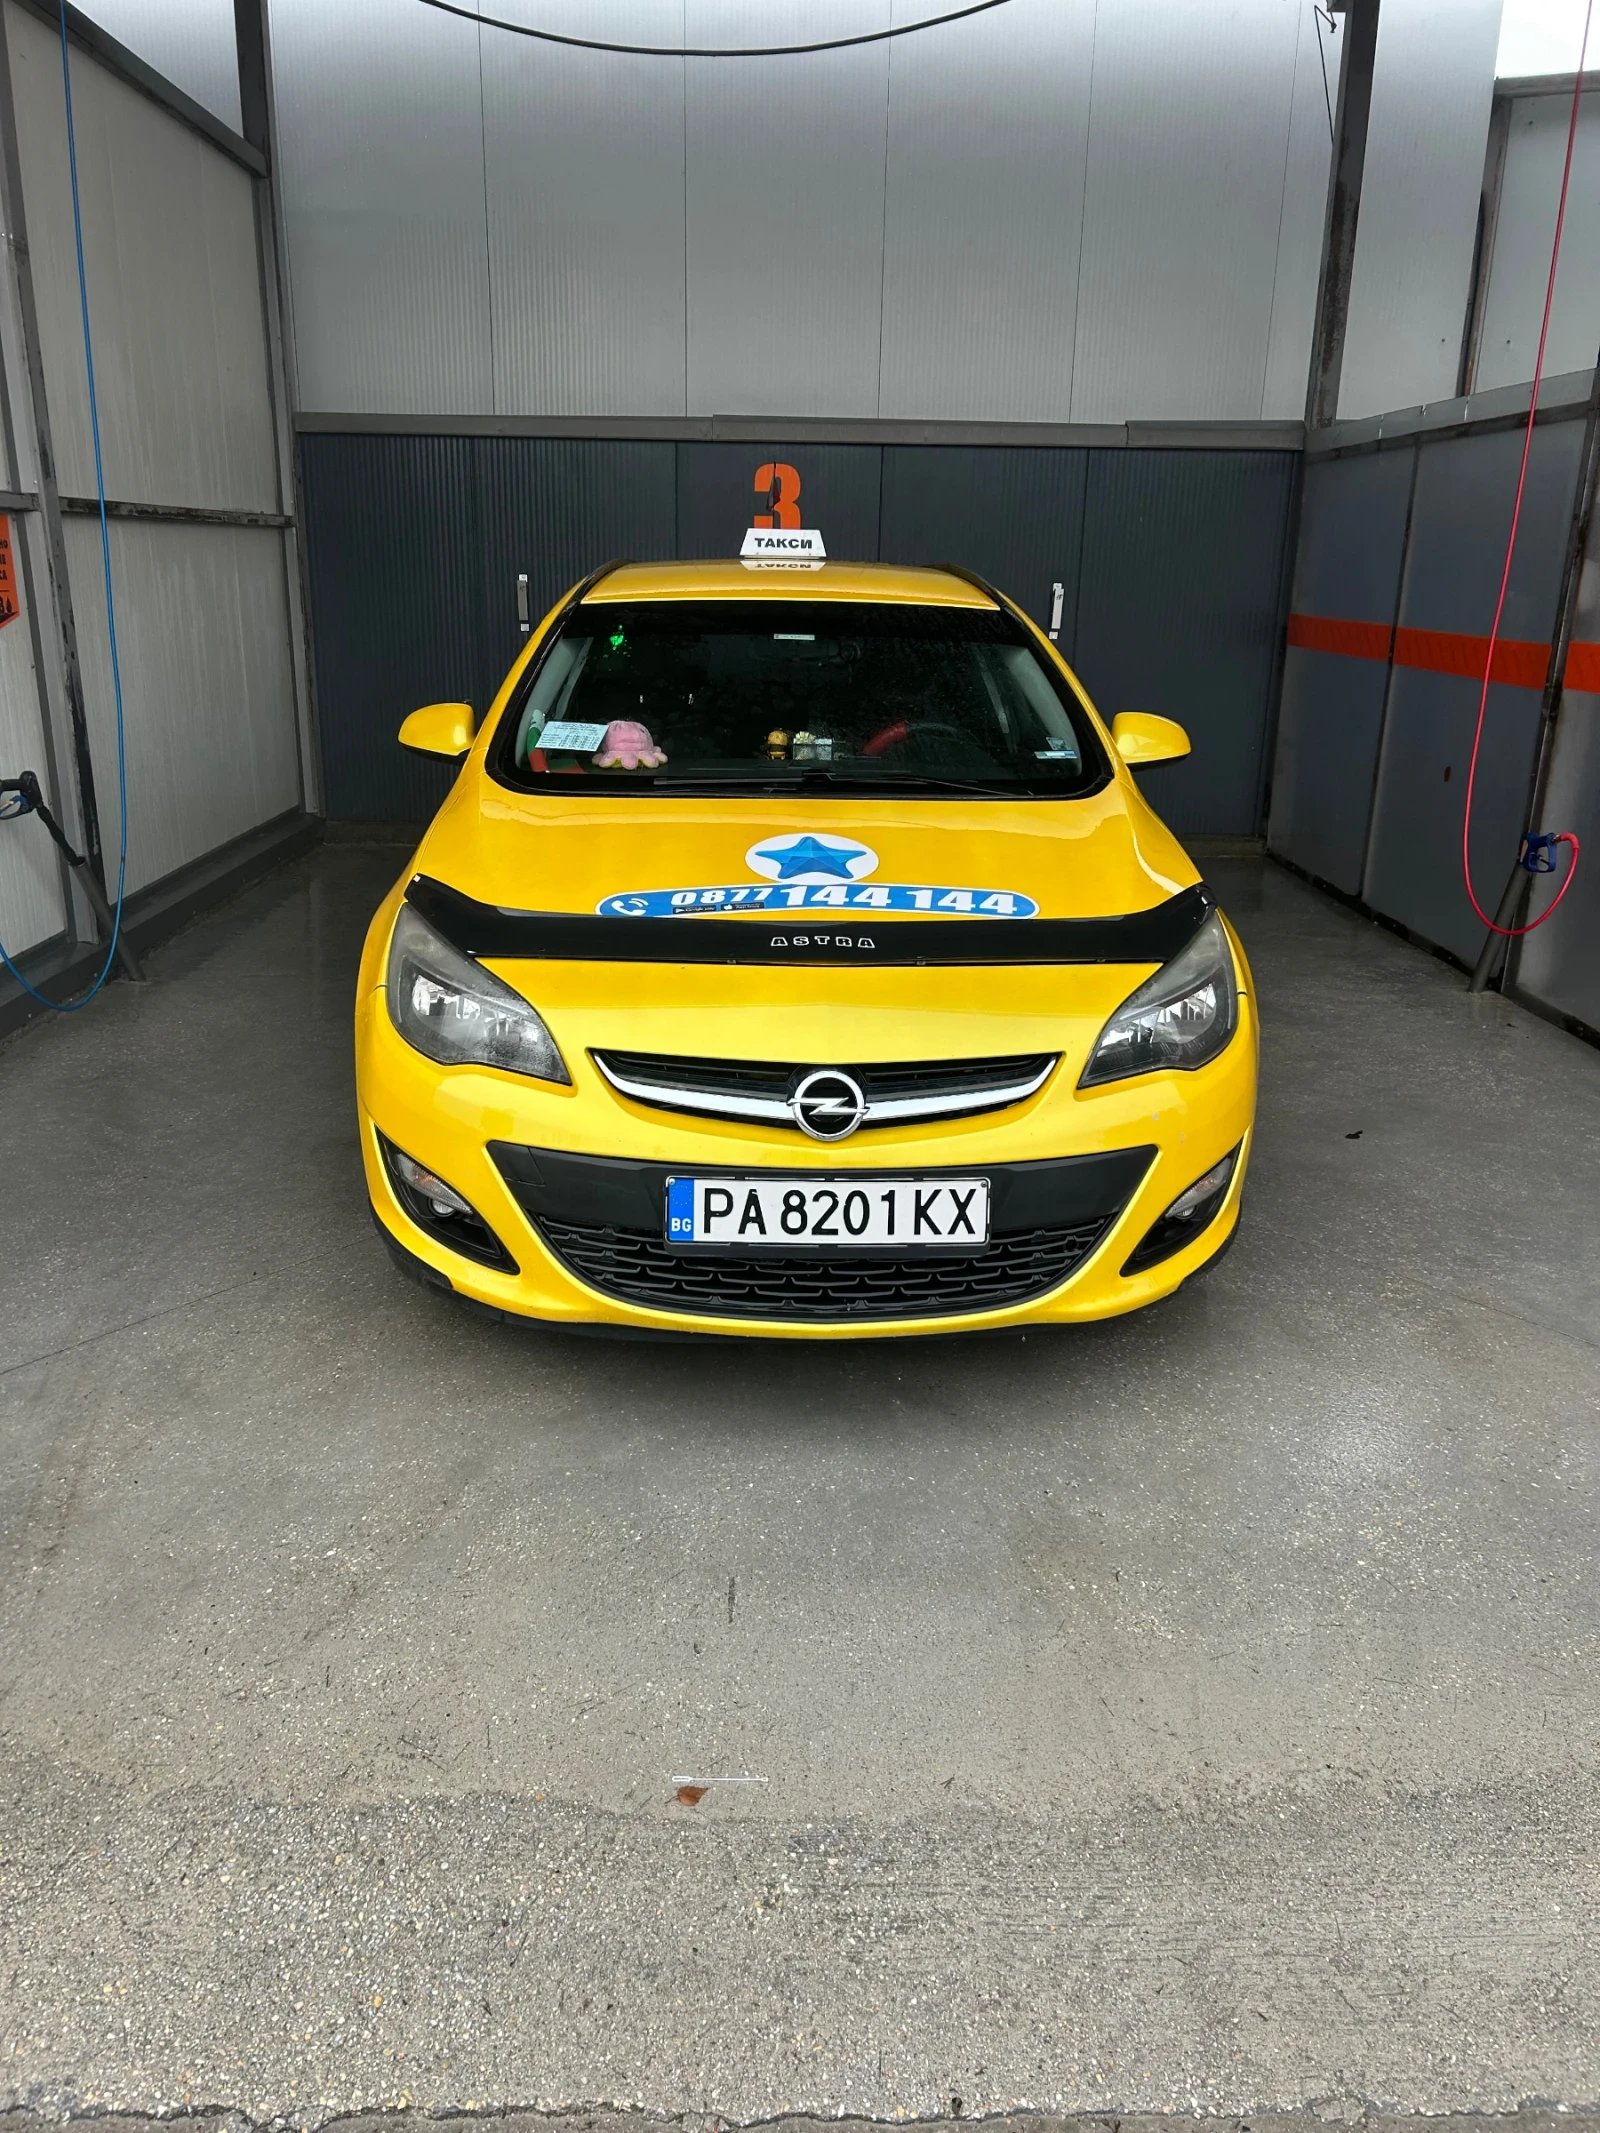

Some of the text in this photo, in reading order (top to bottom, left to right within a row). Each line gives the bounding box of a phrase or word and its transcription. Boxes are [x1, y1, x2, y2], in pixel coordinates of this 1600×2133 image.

[754, 463, 801, 530] 3
[754, 537, 813, 549] ТАКСИ
[671, 885, 1017, 914] 0877 144 144
[770, 935, 875, 948] ASTRA
[703, 1187, 977, 1236] PA 8201 KX
[671, 1218, 692, 1232] BG
